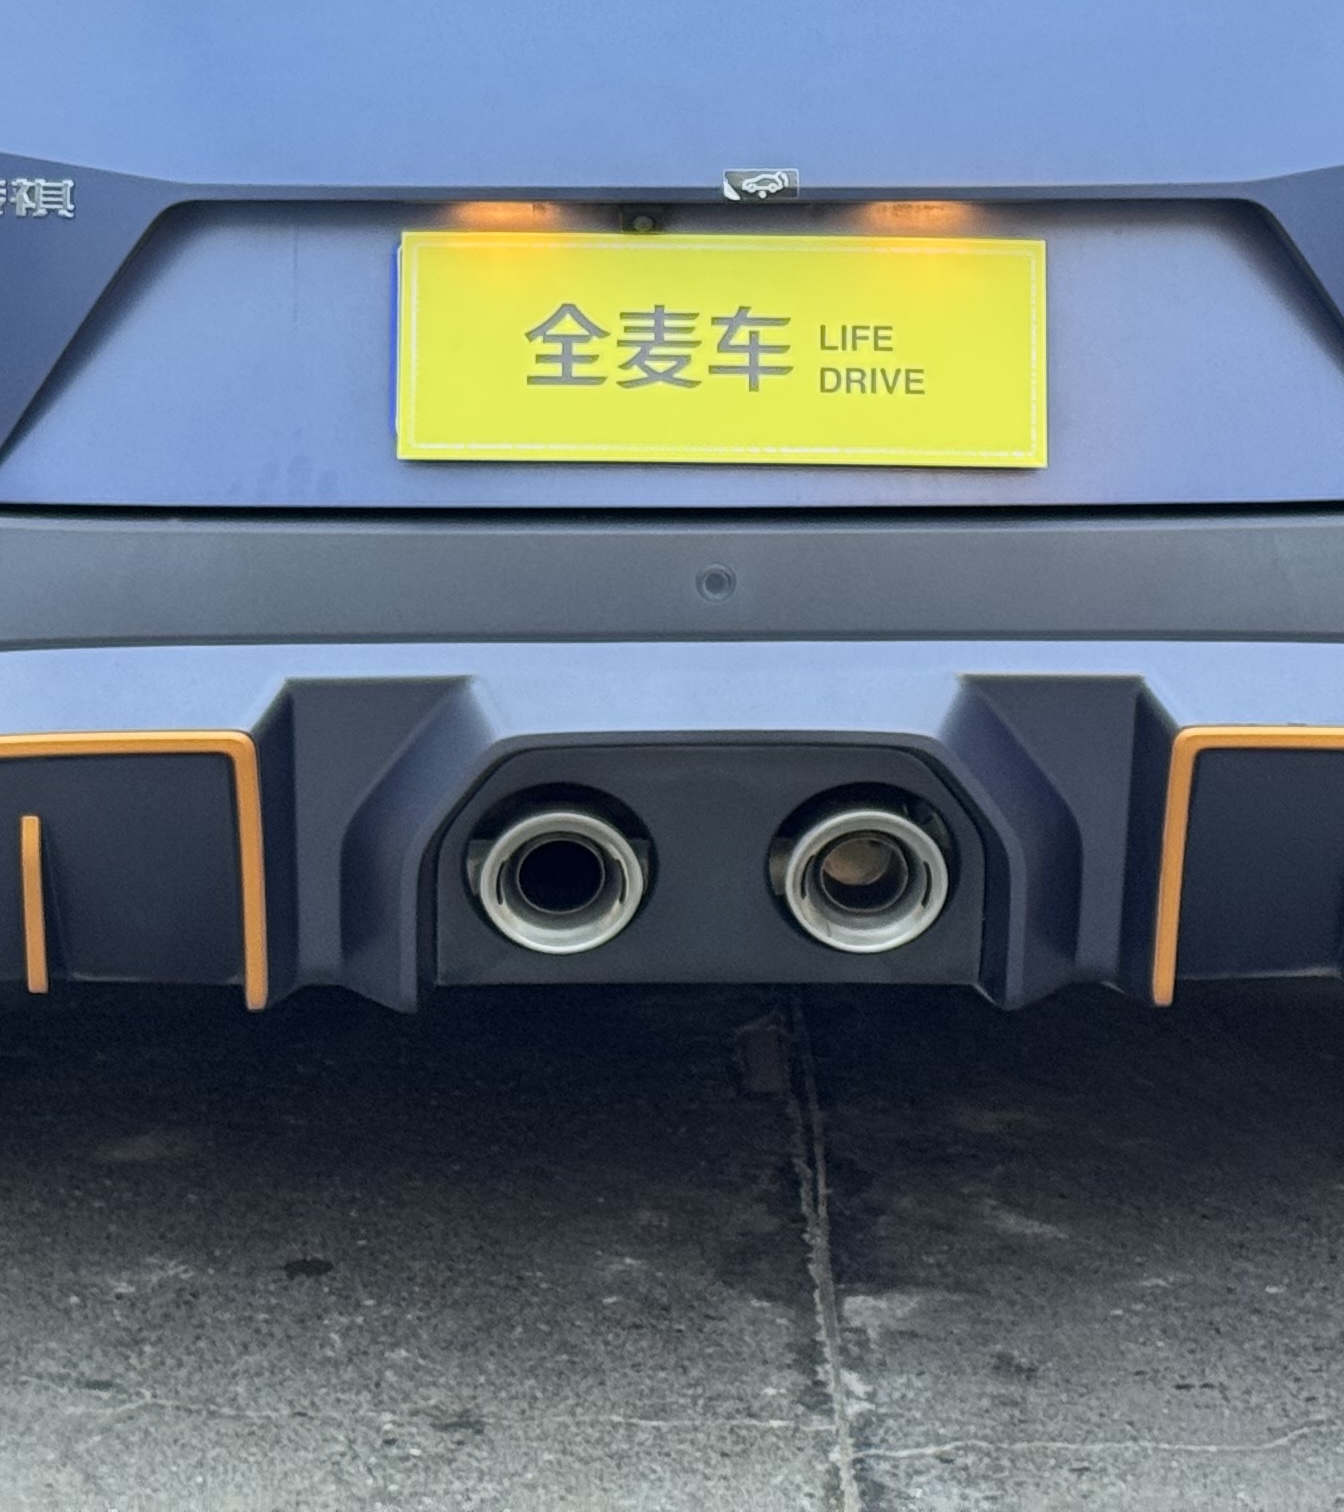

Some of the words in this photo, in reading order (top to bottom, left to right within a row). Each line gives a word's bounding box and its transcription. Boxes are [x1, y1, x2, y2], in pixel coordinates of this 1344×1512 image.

[524, 301, 795, 393] 全麦车
[818, 323, 895, 352] LIFE
[818, 366, 927, 395] DRIVE
